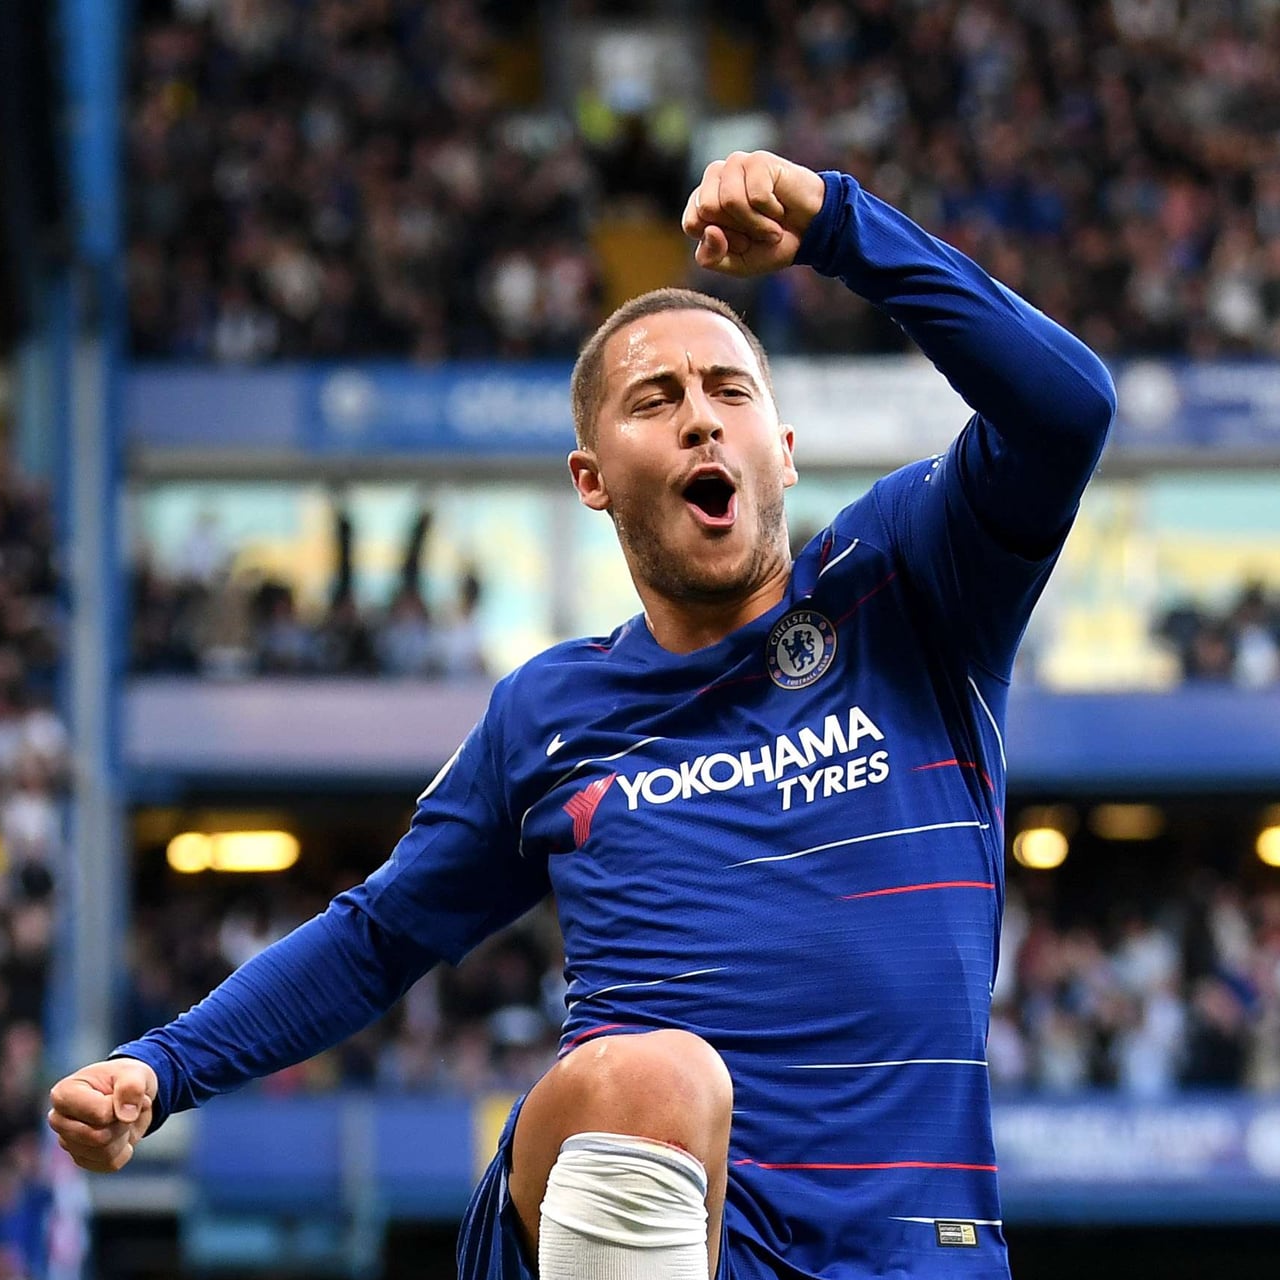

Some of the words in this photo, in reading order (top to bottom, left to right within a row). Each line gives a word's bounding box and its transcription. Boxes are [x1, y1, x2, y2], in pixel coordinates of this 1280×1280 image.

[770, 614, 812, 646] CHELSEA
[616, 706, 885, 811] YOKOHAMA
[777, 750, 889, 811] TYRES
